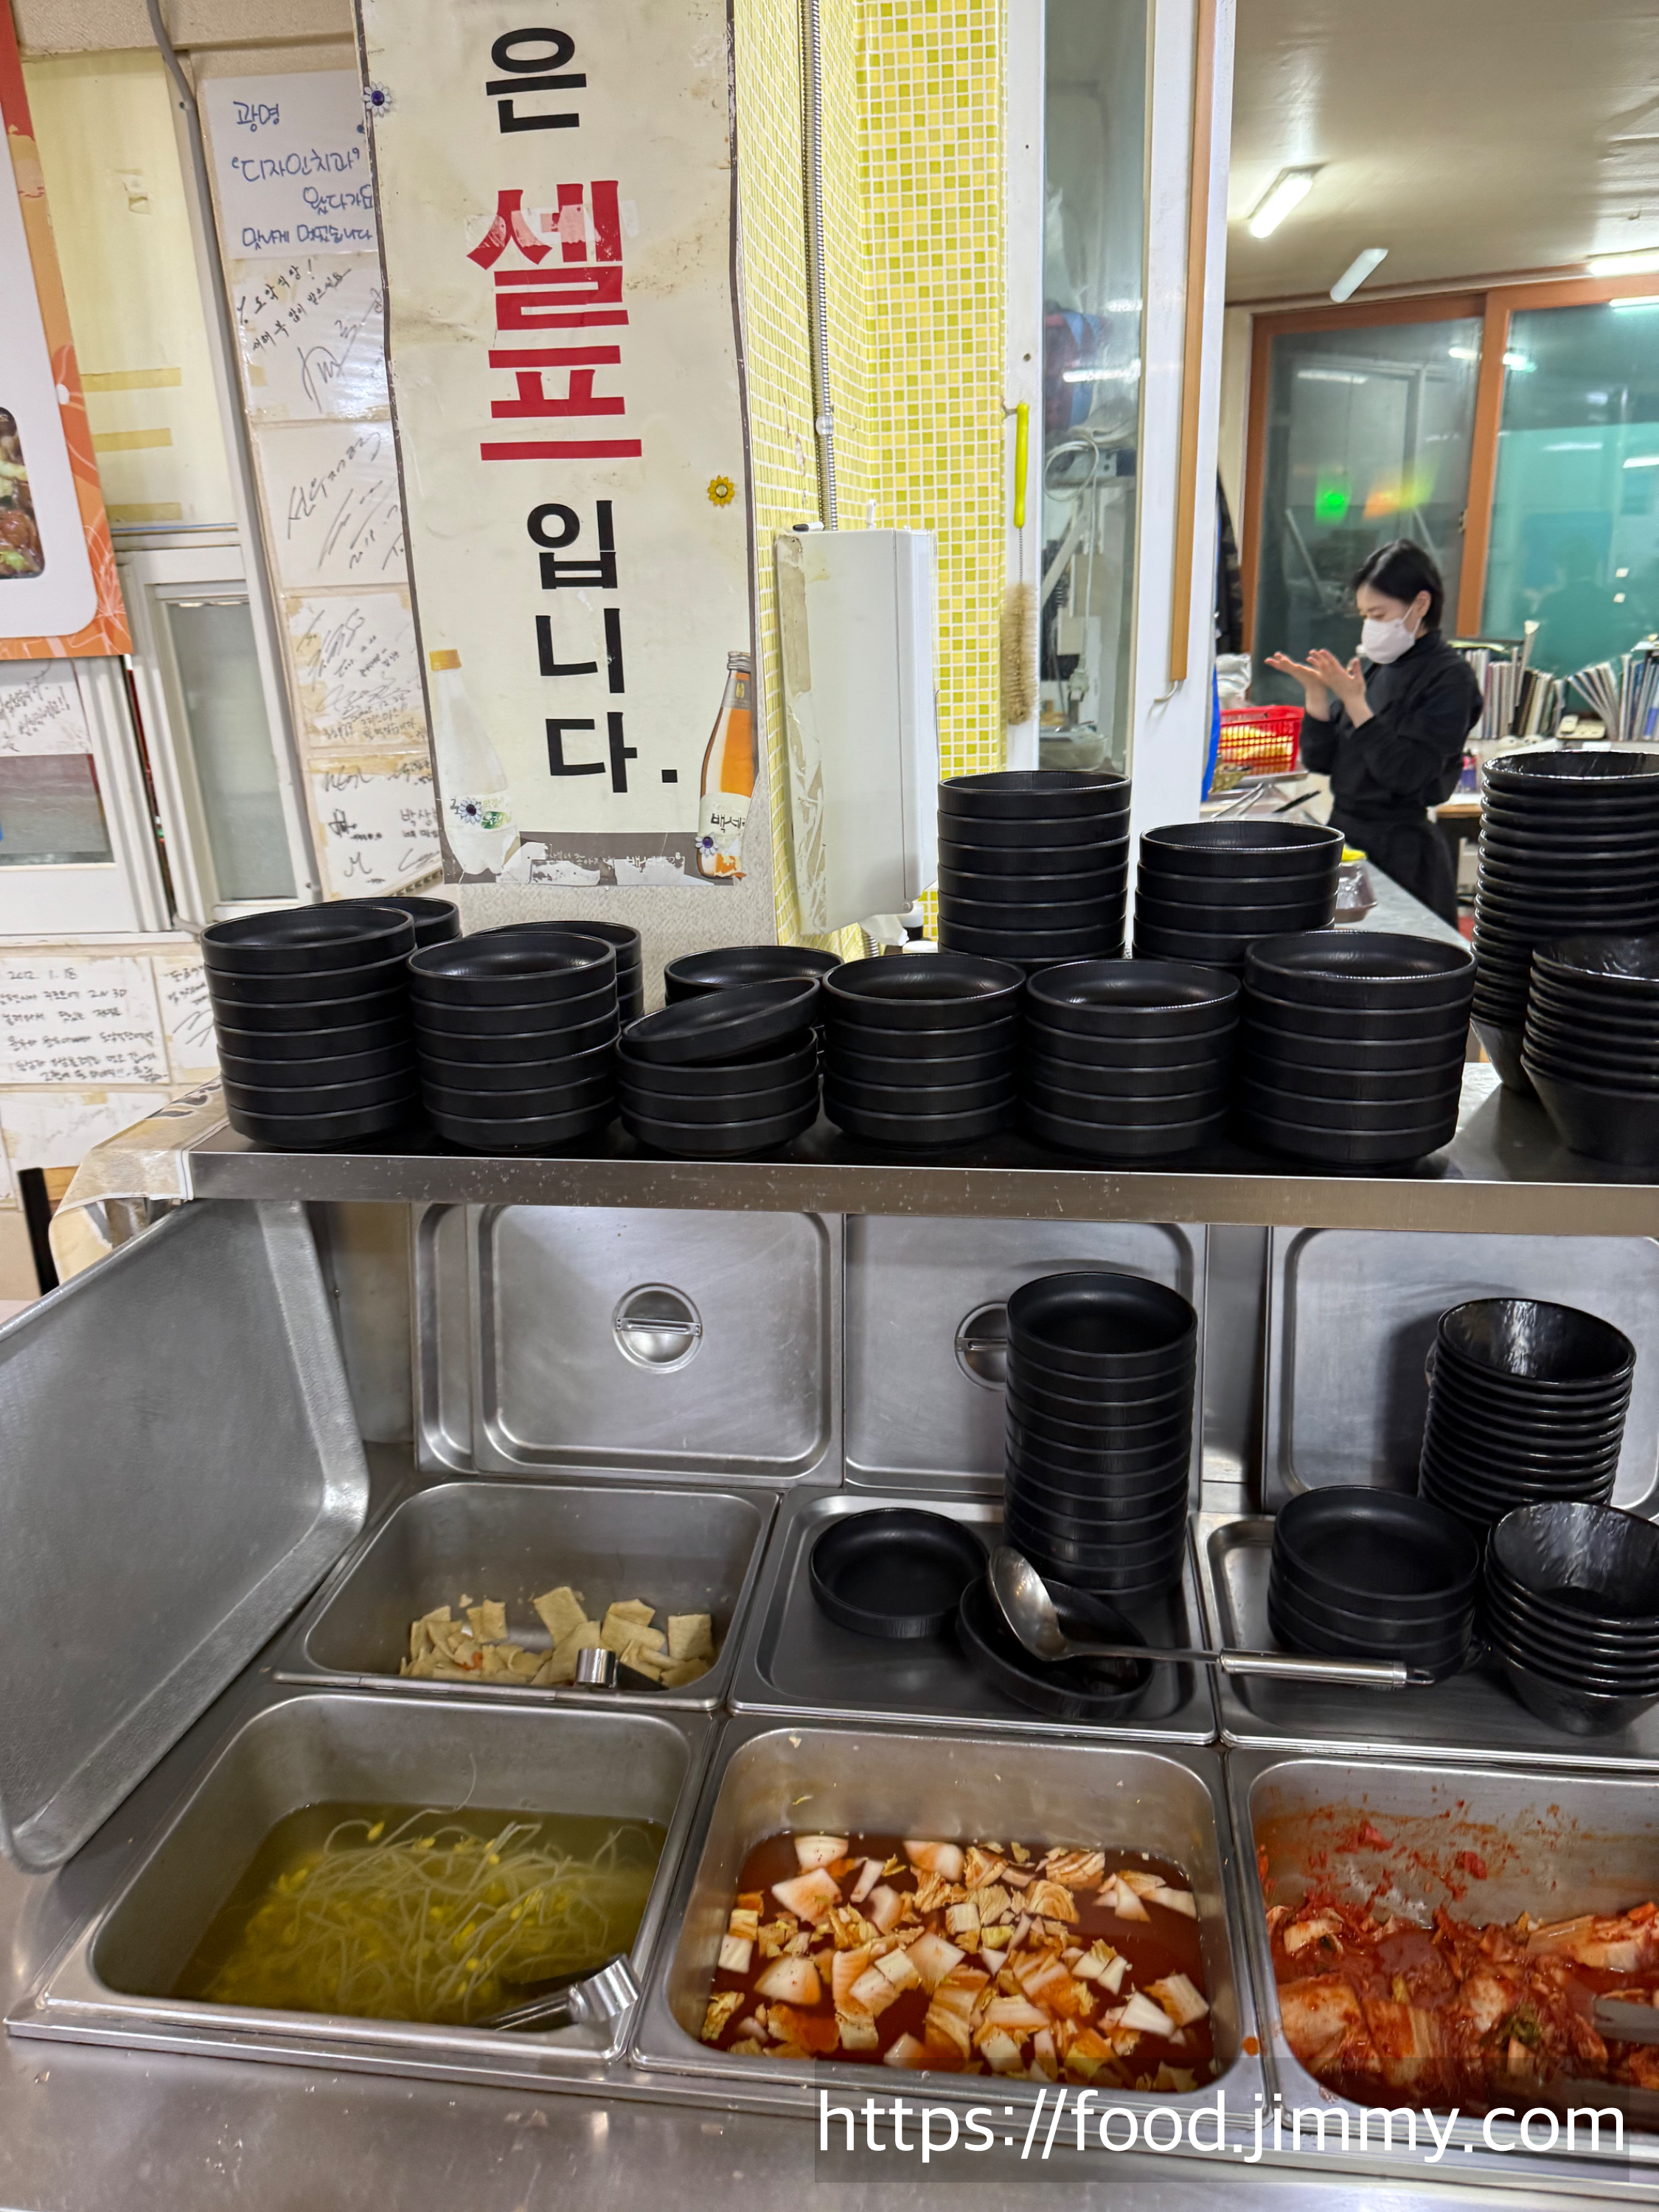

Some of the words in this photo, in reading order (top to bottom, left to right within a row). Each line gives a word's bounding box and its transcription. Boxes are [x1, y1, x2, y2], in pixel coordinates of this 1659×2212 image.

[486, 27, 586, 133] 은
[233, 100, 279, 132] 광명
[274, 319, 291, 338] 복
[466, 181, 641, 460] 셀프
